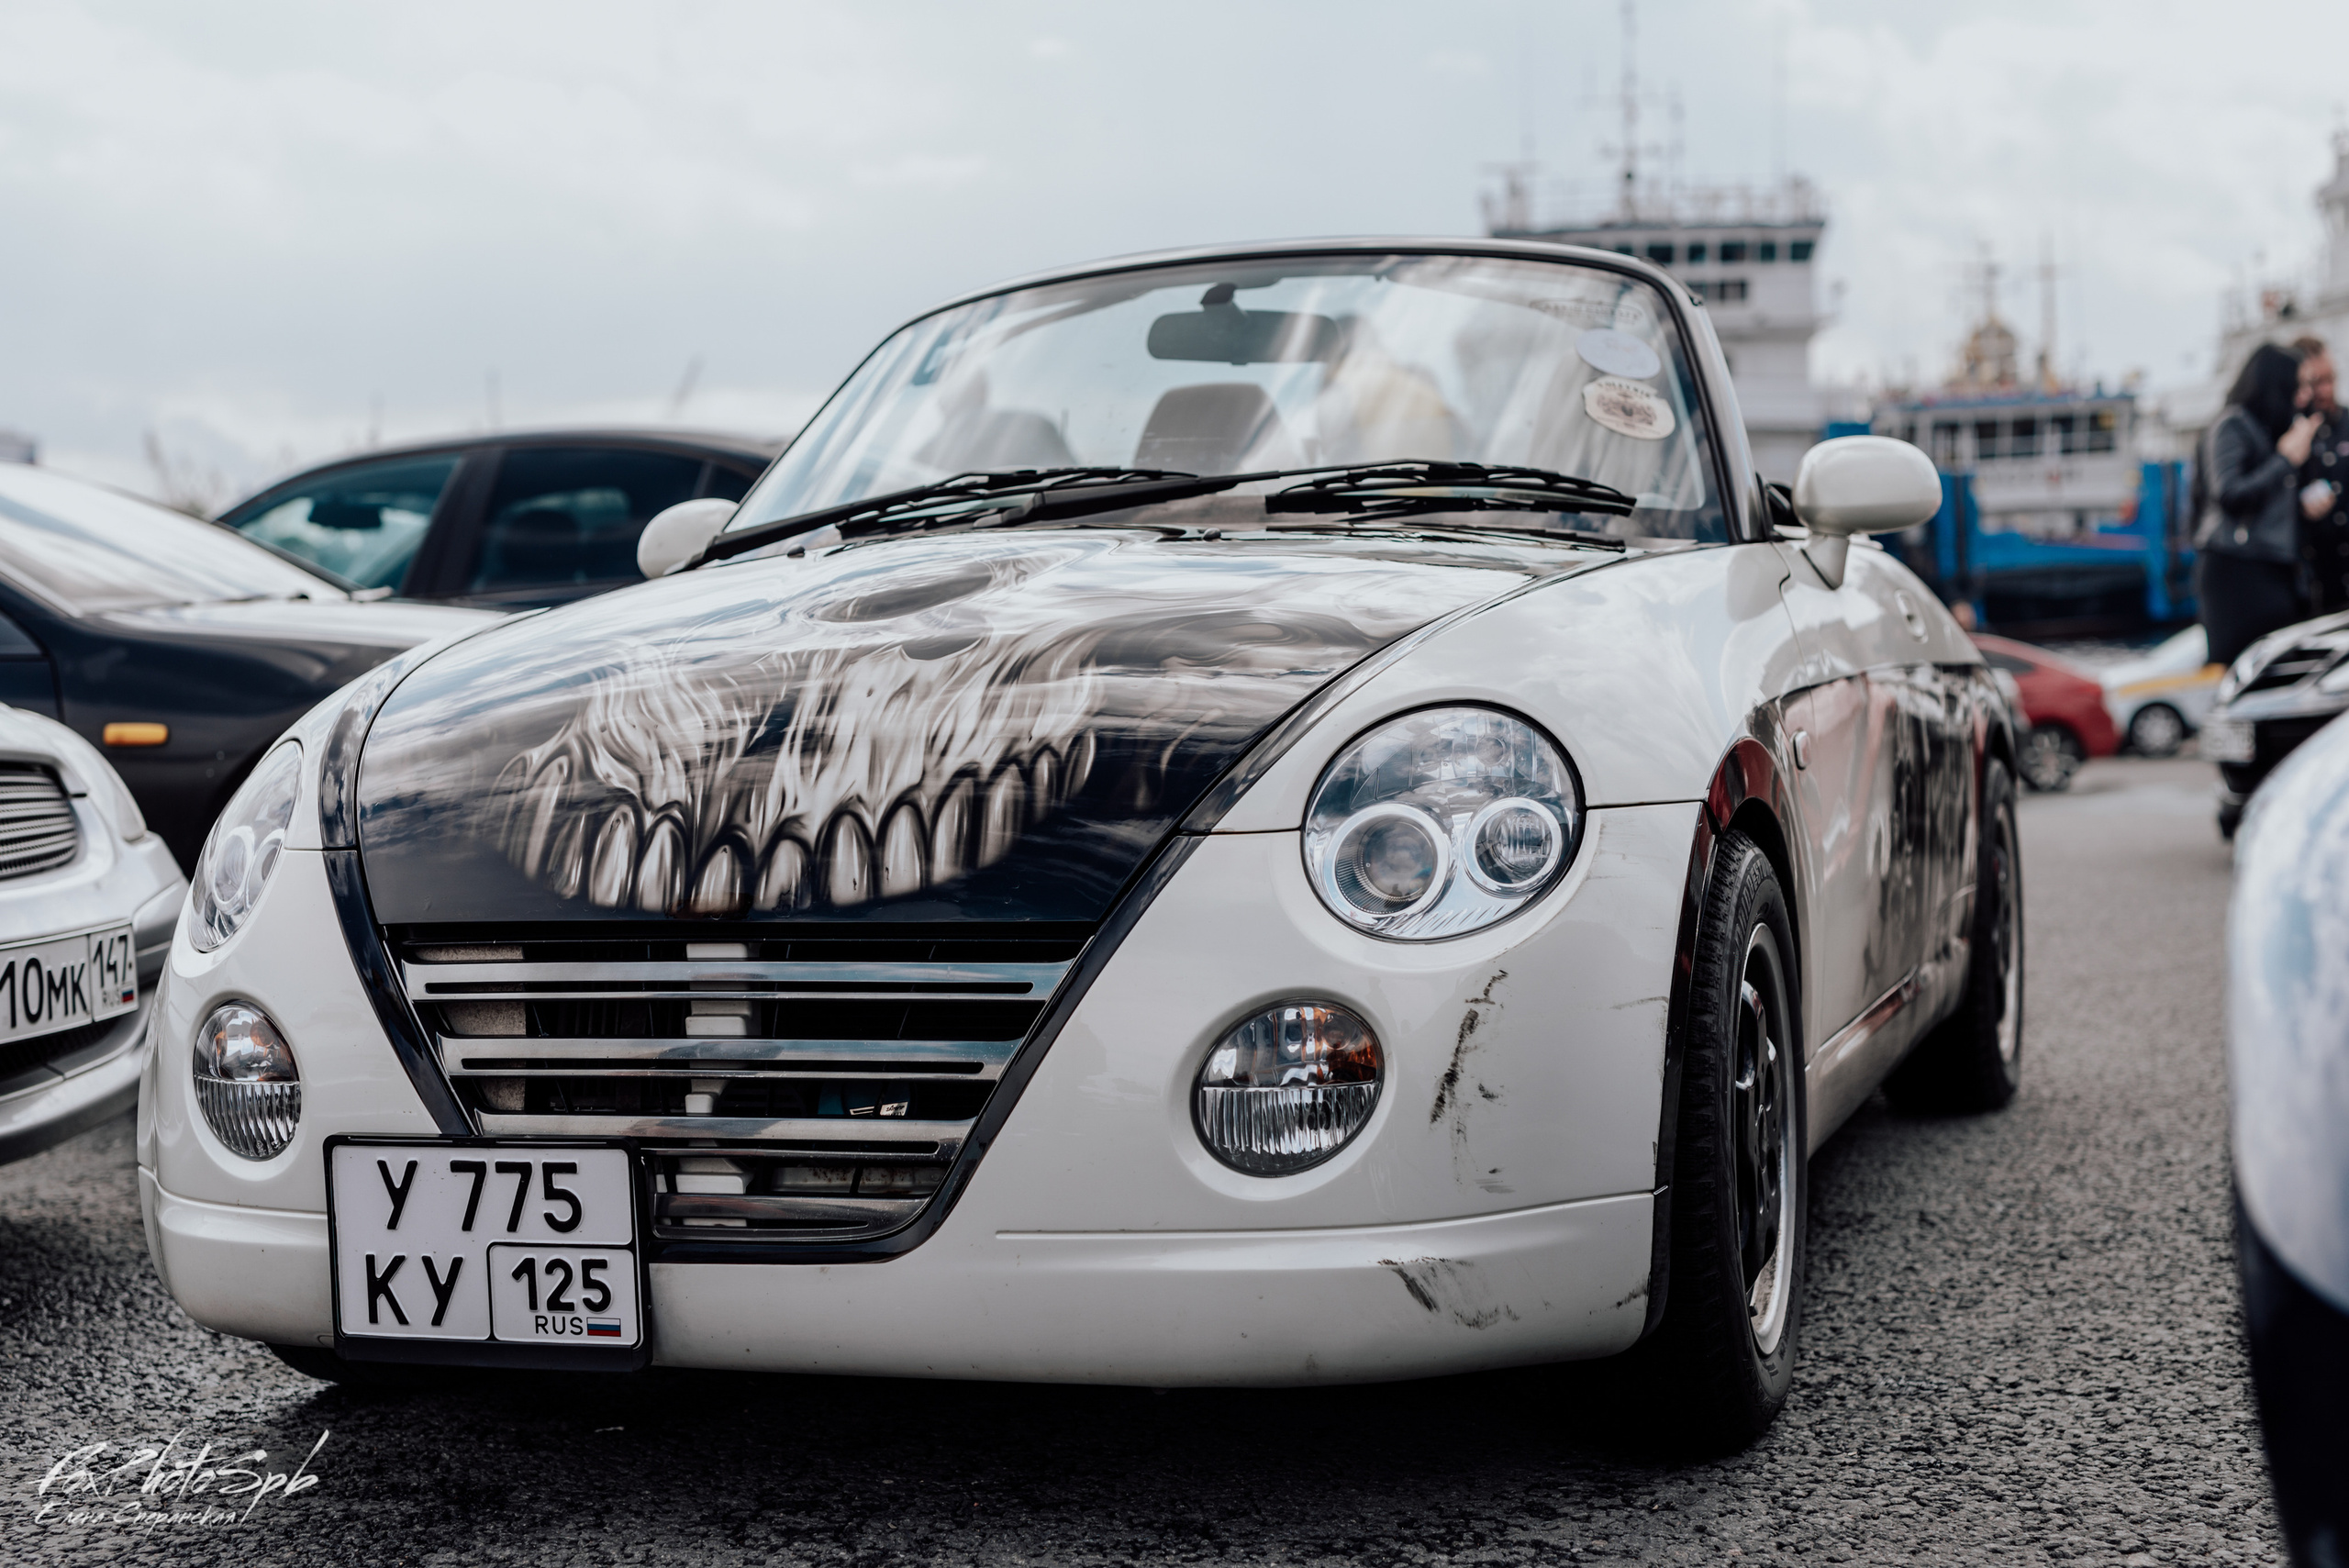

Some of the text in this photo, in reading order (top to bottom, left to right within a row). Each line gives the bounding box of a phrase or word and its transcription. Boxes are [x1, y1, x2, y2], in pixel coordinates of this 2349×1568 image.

[93, 934, 128, 988] 147
[376, 1159, 583, 1233] У 775
[365, 1253, 612, 1327] КУ 125
[534, 1316, 584, 1336] RUS
